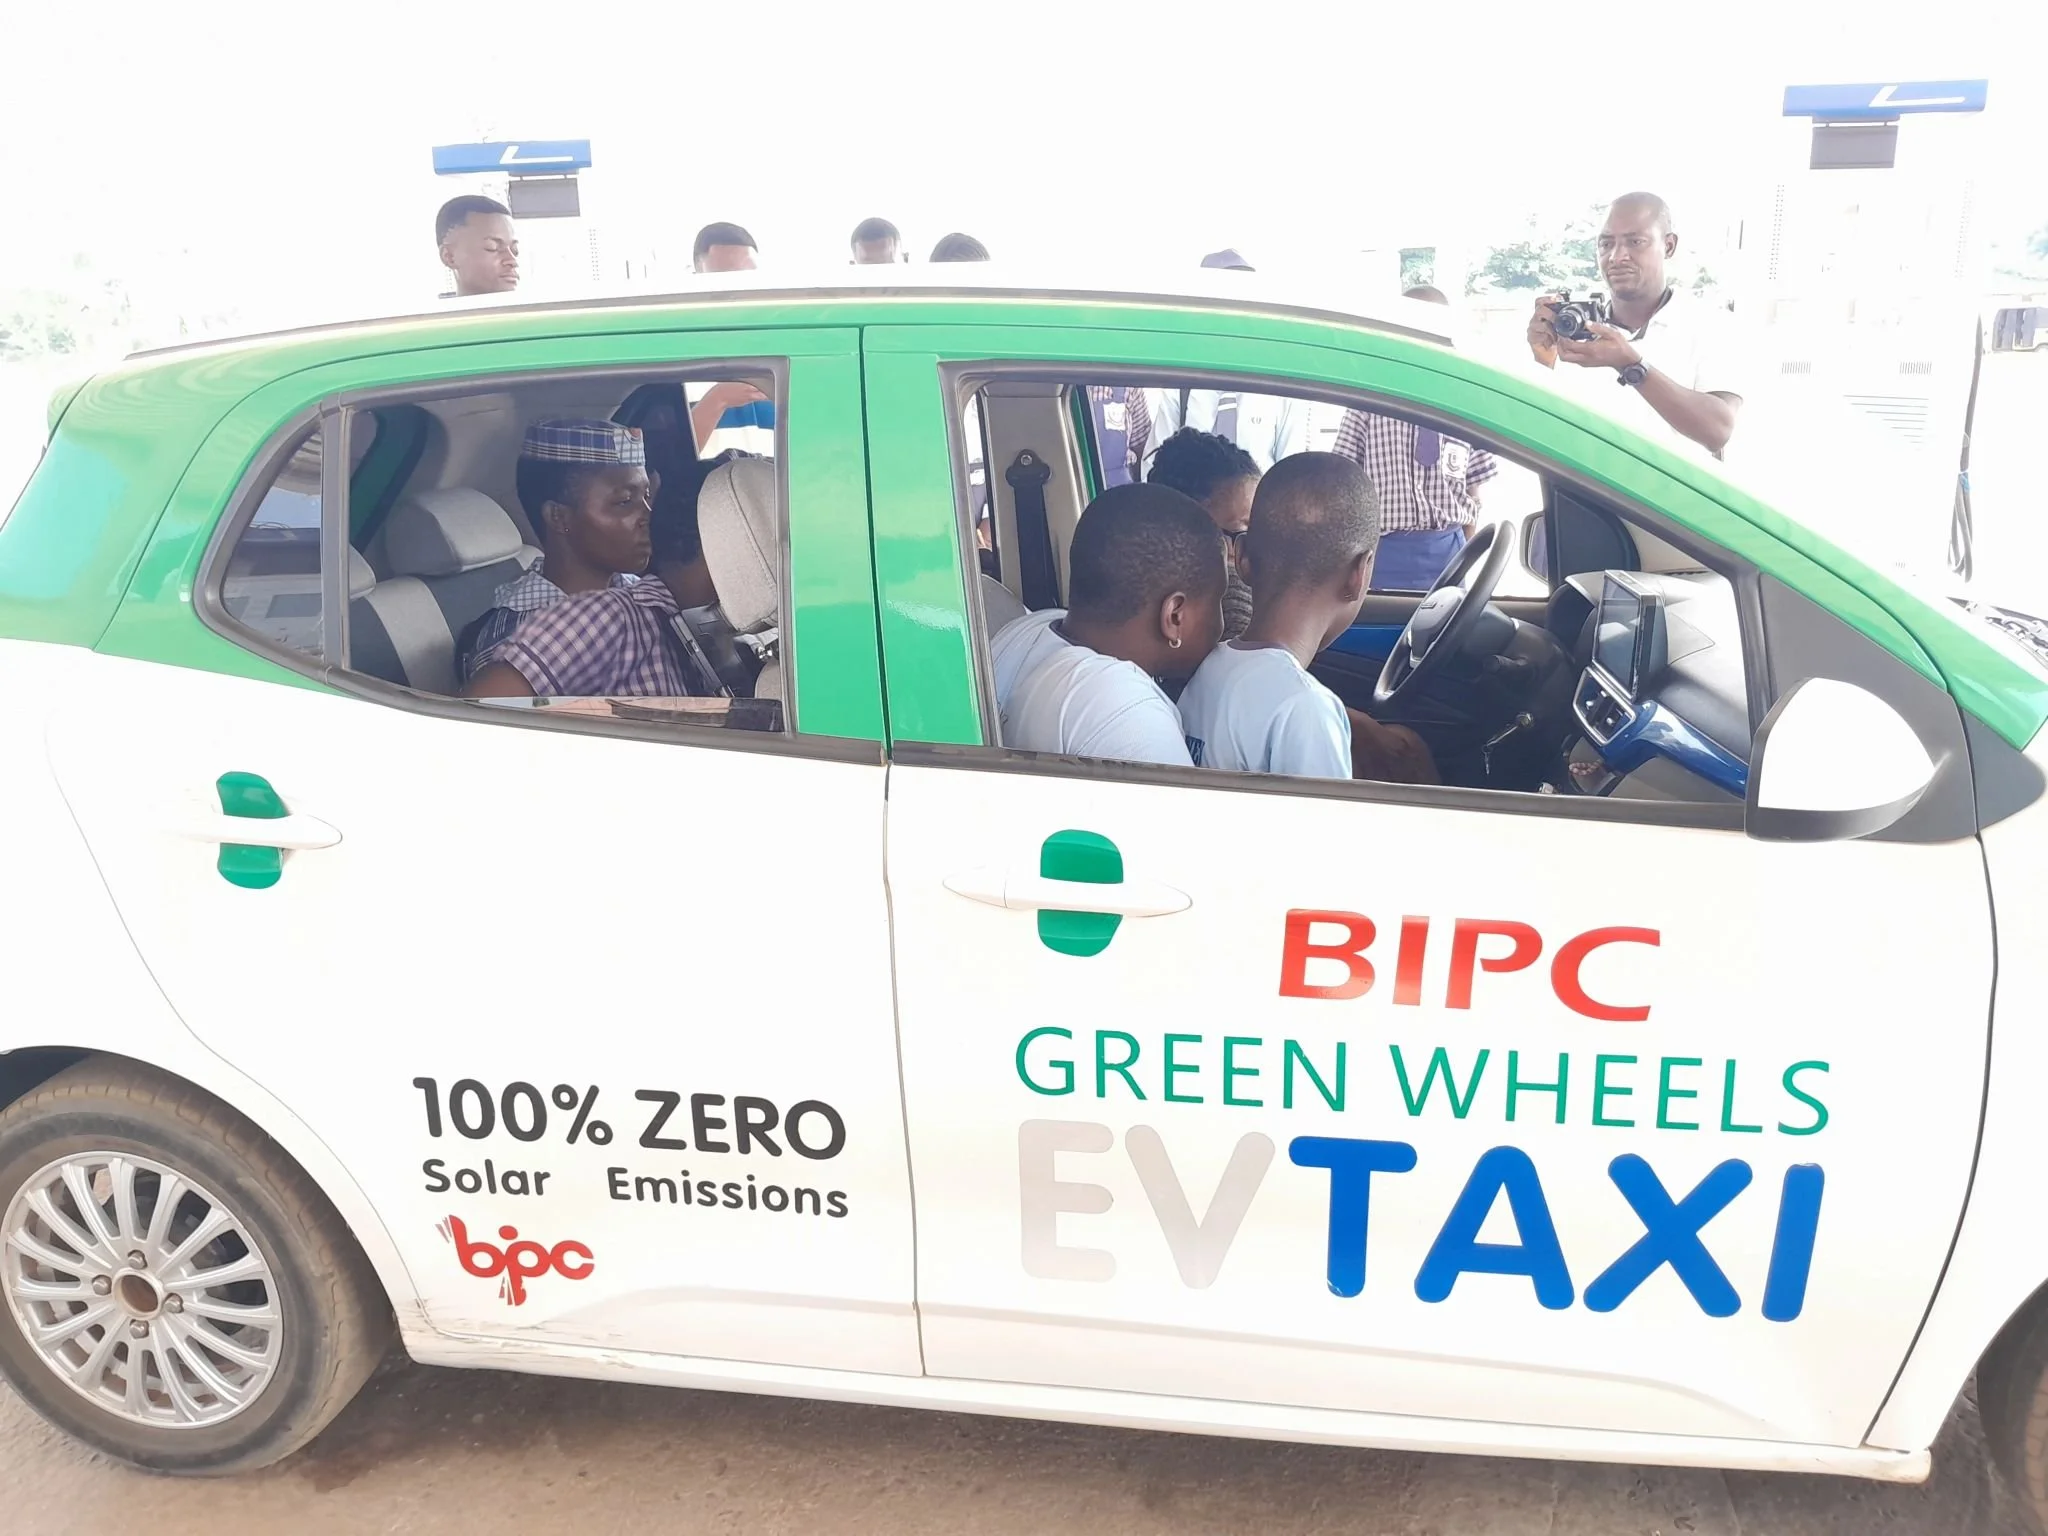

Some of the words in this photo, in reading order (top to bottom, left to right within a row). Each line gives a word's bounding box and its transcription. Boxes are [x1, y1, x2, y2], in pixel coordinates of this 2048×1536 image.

[1279, 908, 1661, 1022] BIPC
[412, 1077, 614, 1146] 100%
[634, 1089, 847, 1161] ZERO
[1015, 1026, 1347, 1114] GREEN
[1390, 1044, 1832, 1137] WHEELS
[422, 1158, 552, 1197] Solar
[607, 1166, 850, 1219] Emissions
